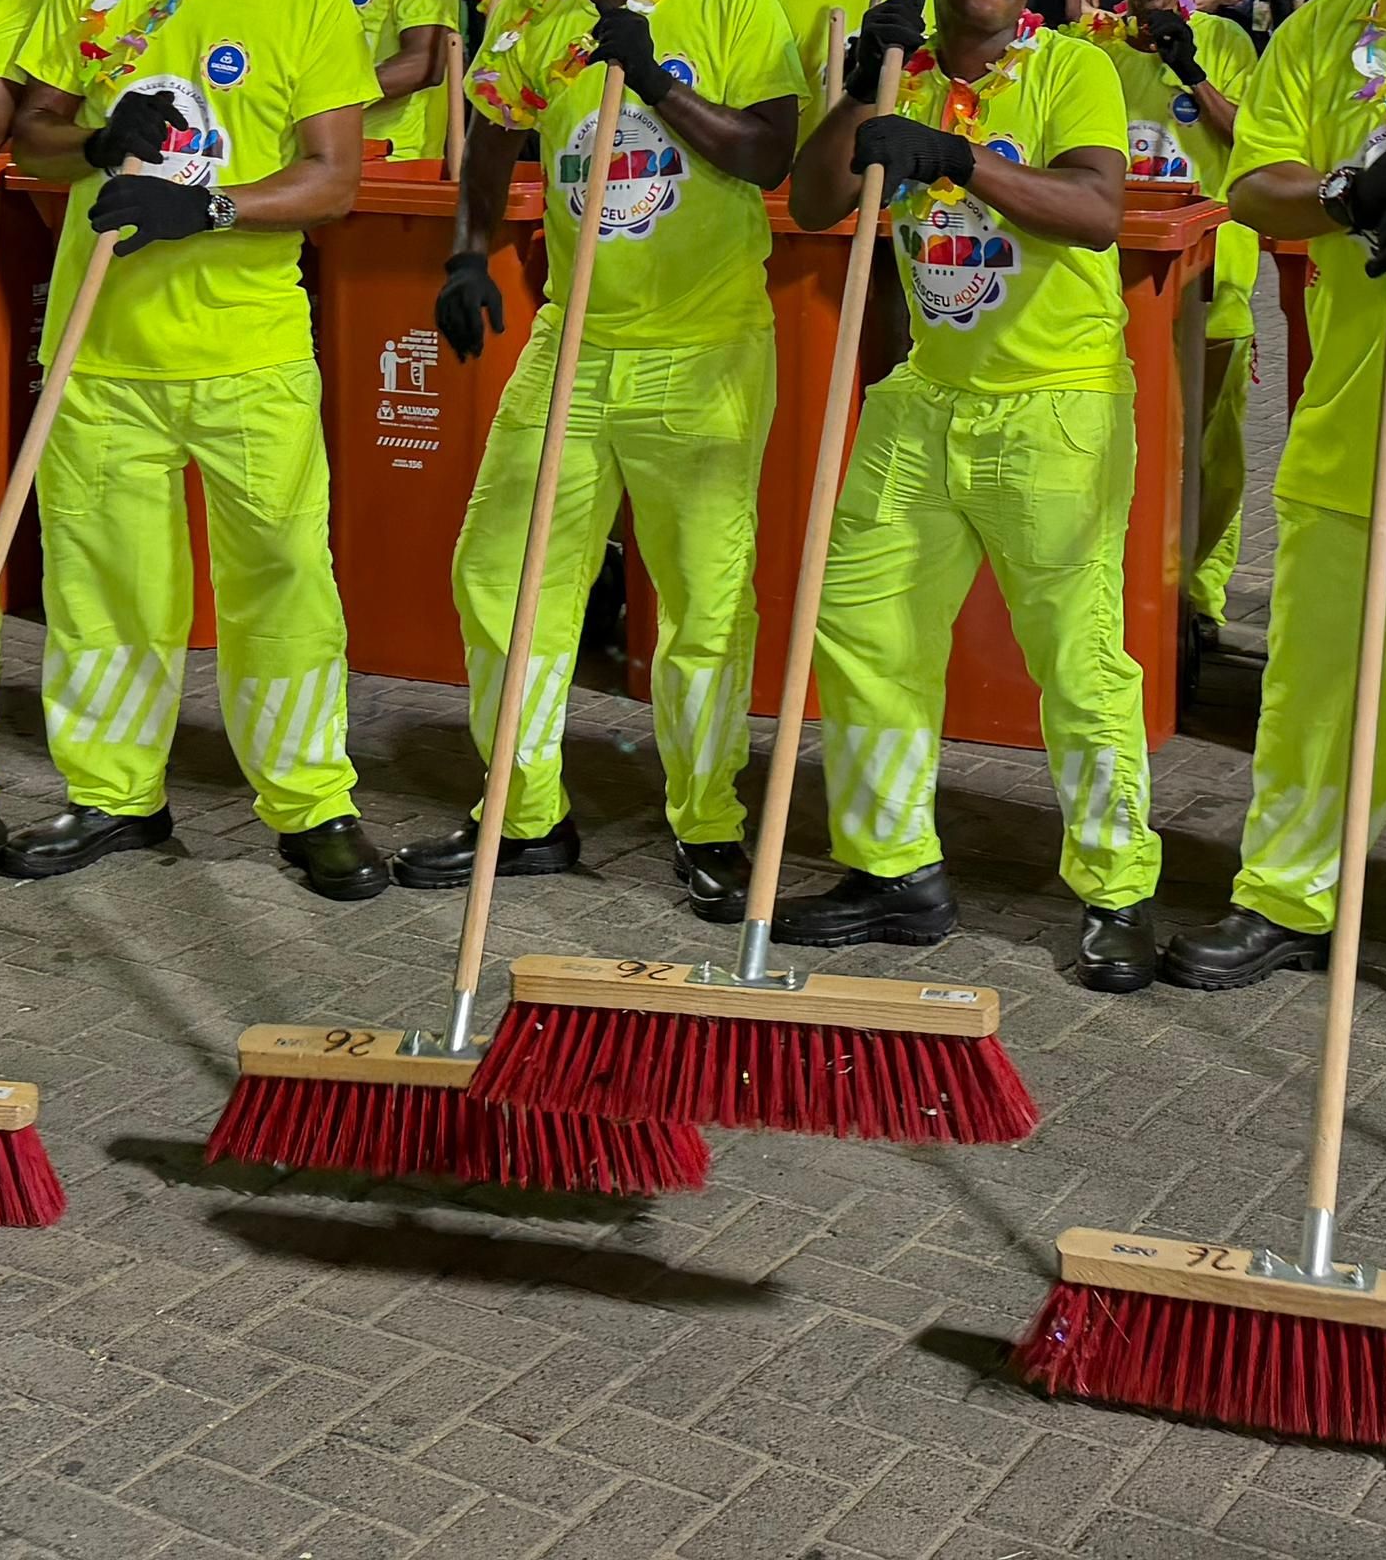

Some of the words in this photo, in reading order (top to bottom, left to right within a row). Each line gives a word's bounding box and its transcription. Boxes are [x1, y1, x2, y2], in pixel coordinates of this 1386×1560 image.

[630, 182, 662, 217] AQUI
[954, 272, 986, 307] AQUI
[397, 405, 440, 417] SALVADOR
